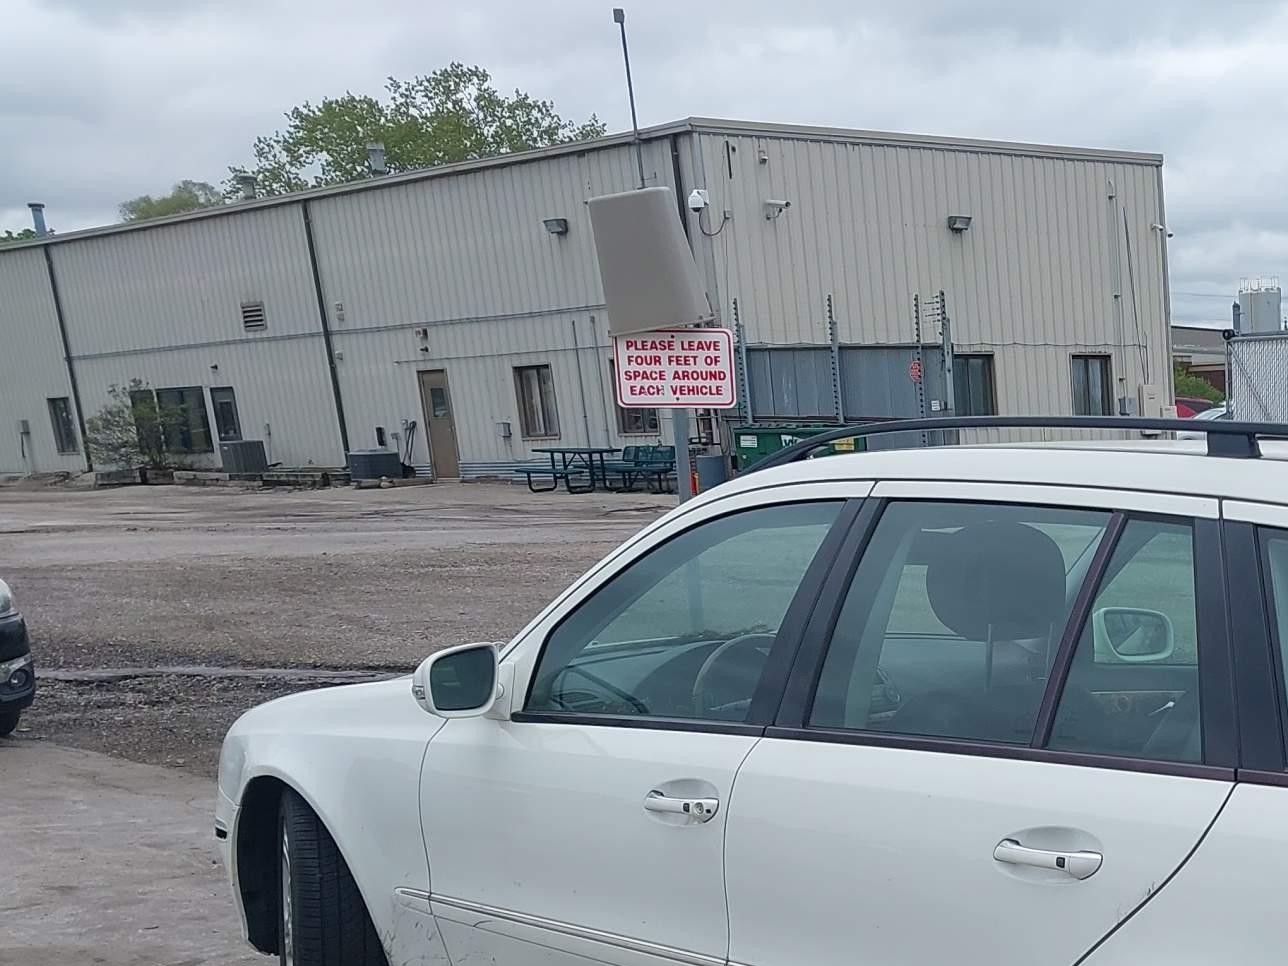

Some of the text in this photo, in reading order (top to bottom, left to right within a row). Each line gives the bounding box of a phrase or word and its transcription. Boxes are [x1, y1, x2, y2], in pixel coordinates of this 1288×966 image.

[625, 340, 721, 351] PLEASE LEAVE
[627, 355, 721, 366] FOUR FEET OF
[624, 370, 726, 381] SPACE AROUND
[629, 385, 723, 396] EACH VEHICLE
